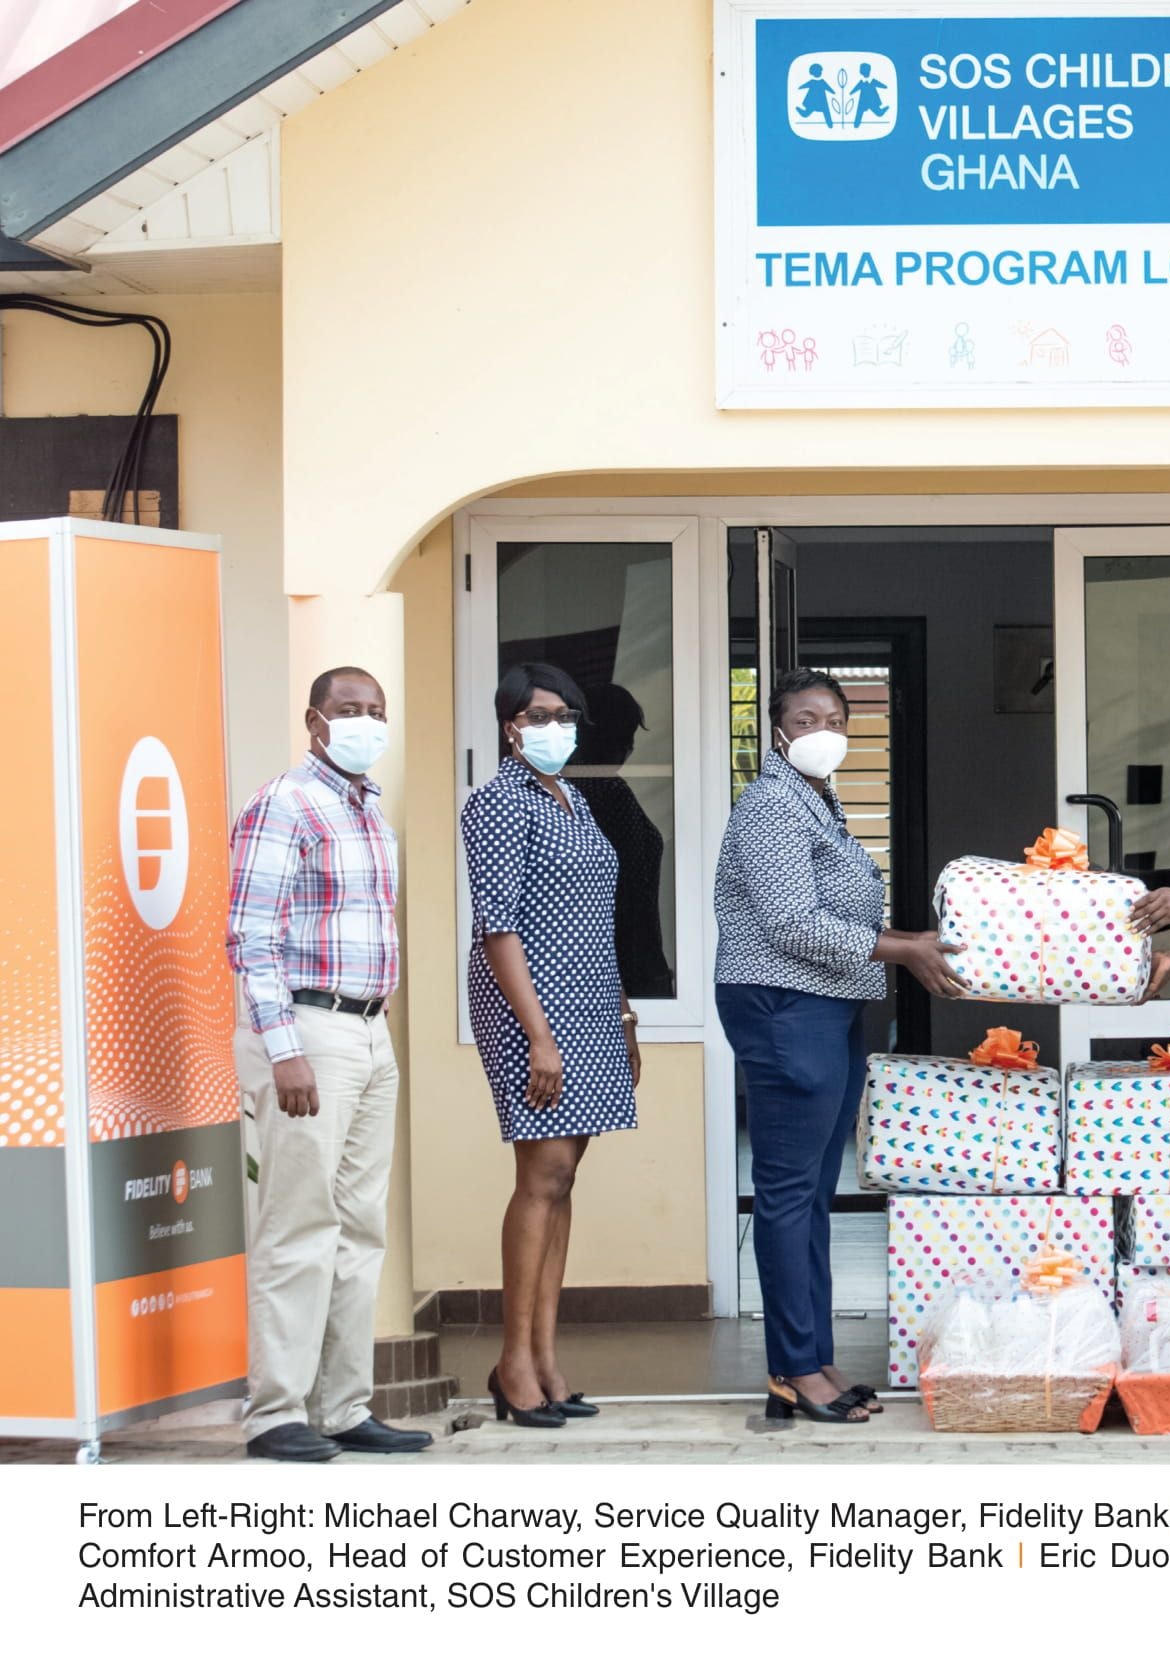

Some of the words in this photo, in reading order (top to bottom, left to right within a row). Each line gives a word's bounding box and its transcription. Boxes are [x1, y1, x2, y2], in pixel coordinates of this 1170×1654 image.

[919, 53, 1012, 90] SOS
[918, 104, 1135, 140] VILLAGES
[921, 153, 1080, 191] GHANA
[755, 252, 884, 288] TEMA
[895, 250, 1127, 286] PROGRAM
[124, 1174, 172, 1202] FIDELITY
[190, 1167, 214, 1190] BANK
